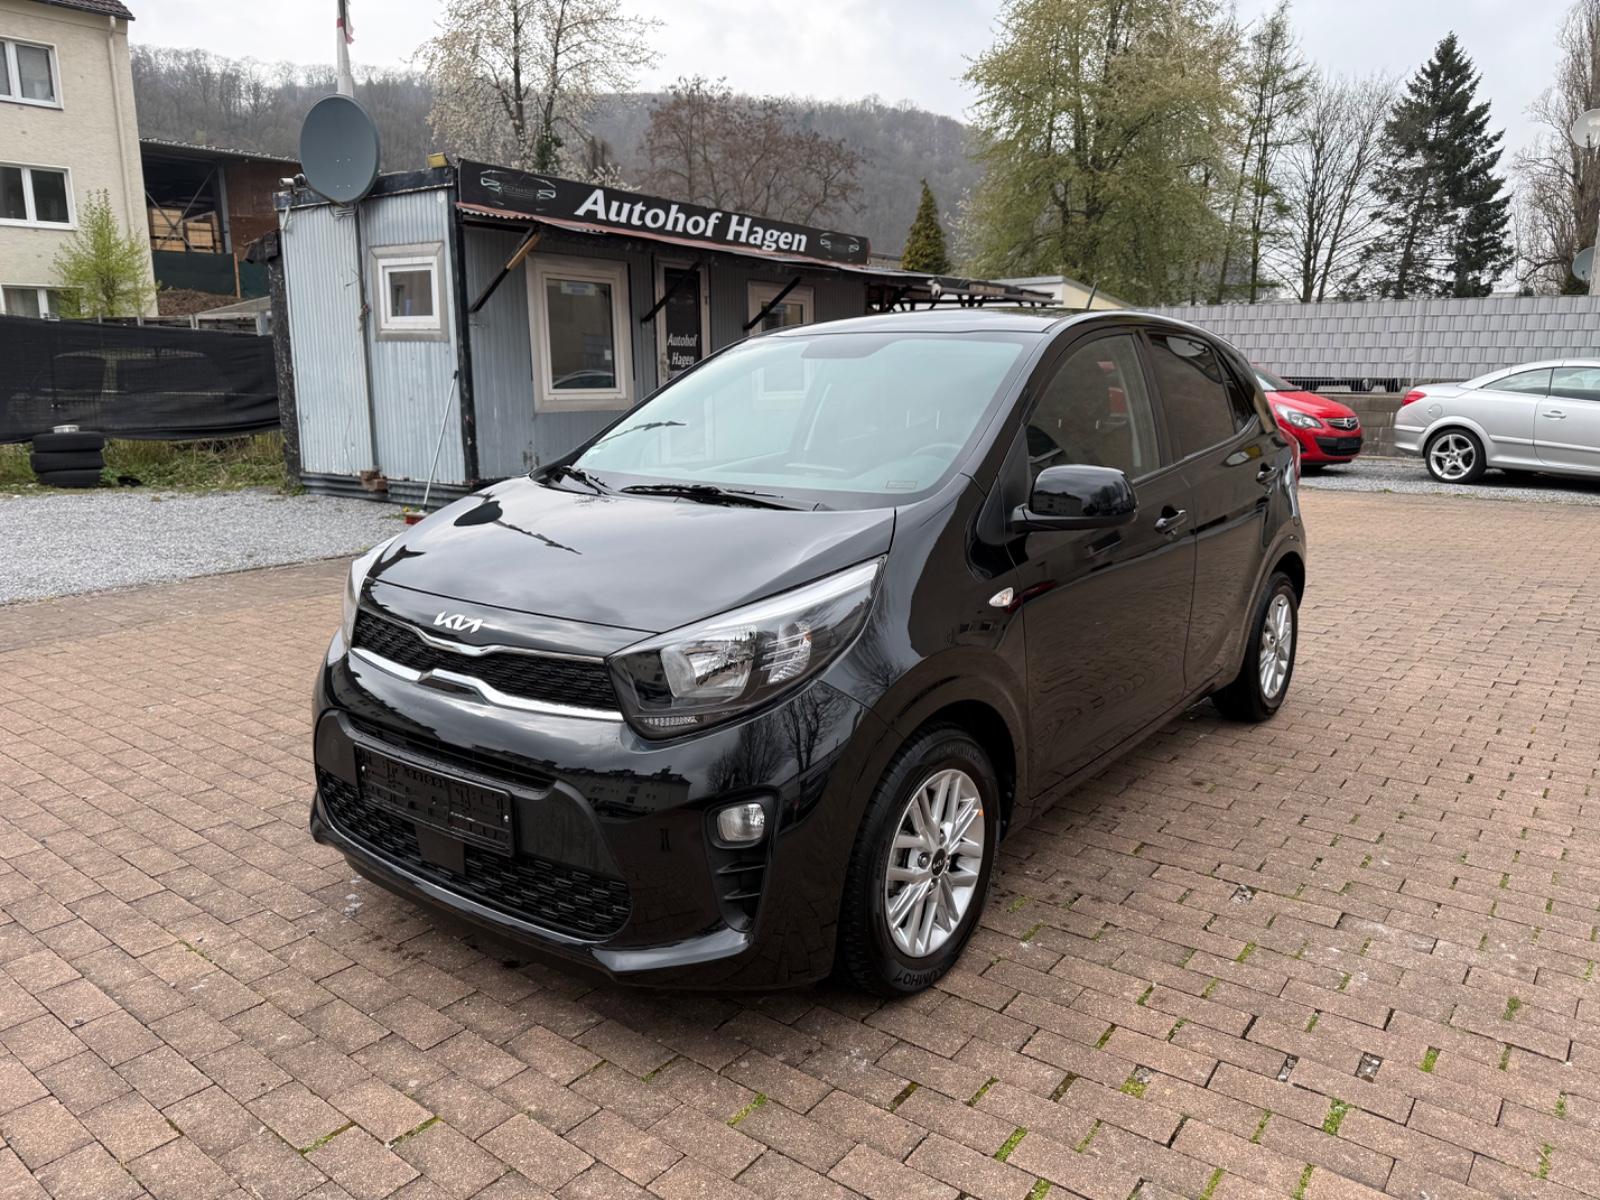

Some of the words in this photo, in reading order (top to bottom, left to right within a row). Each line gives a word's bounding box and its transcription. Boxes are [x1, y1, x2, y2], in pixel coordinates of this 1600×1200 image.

[574, 189, 722, 237] Autohof
[726, 214, 808, 252] Hagen
[667, 333, 698, 347] Autohof
[672, 352, 694, 368] Hagen
[433, 611, 483, 634] KIA
